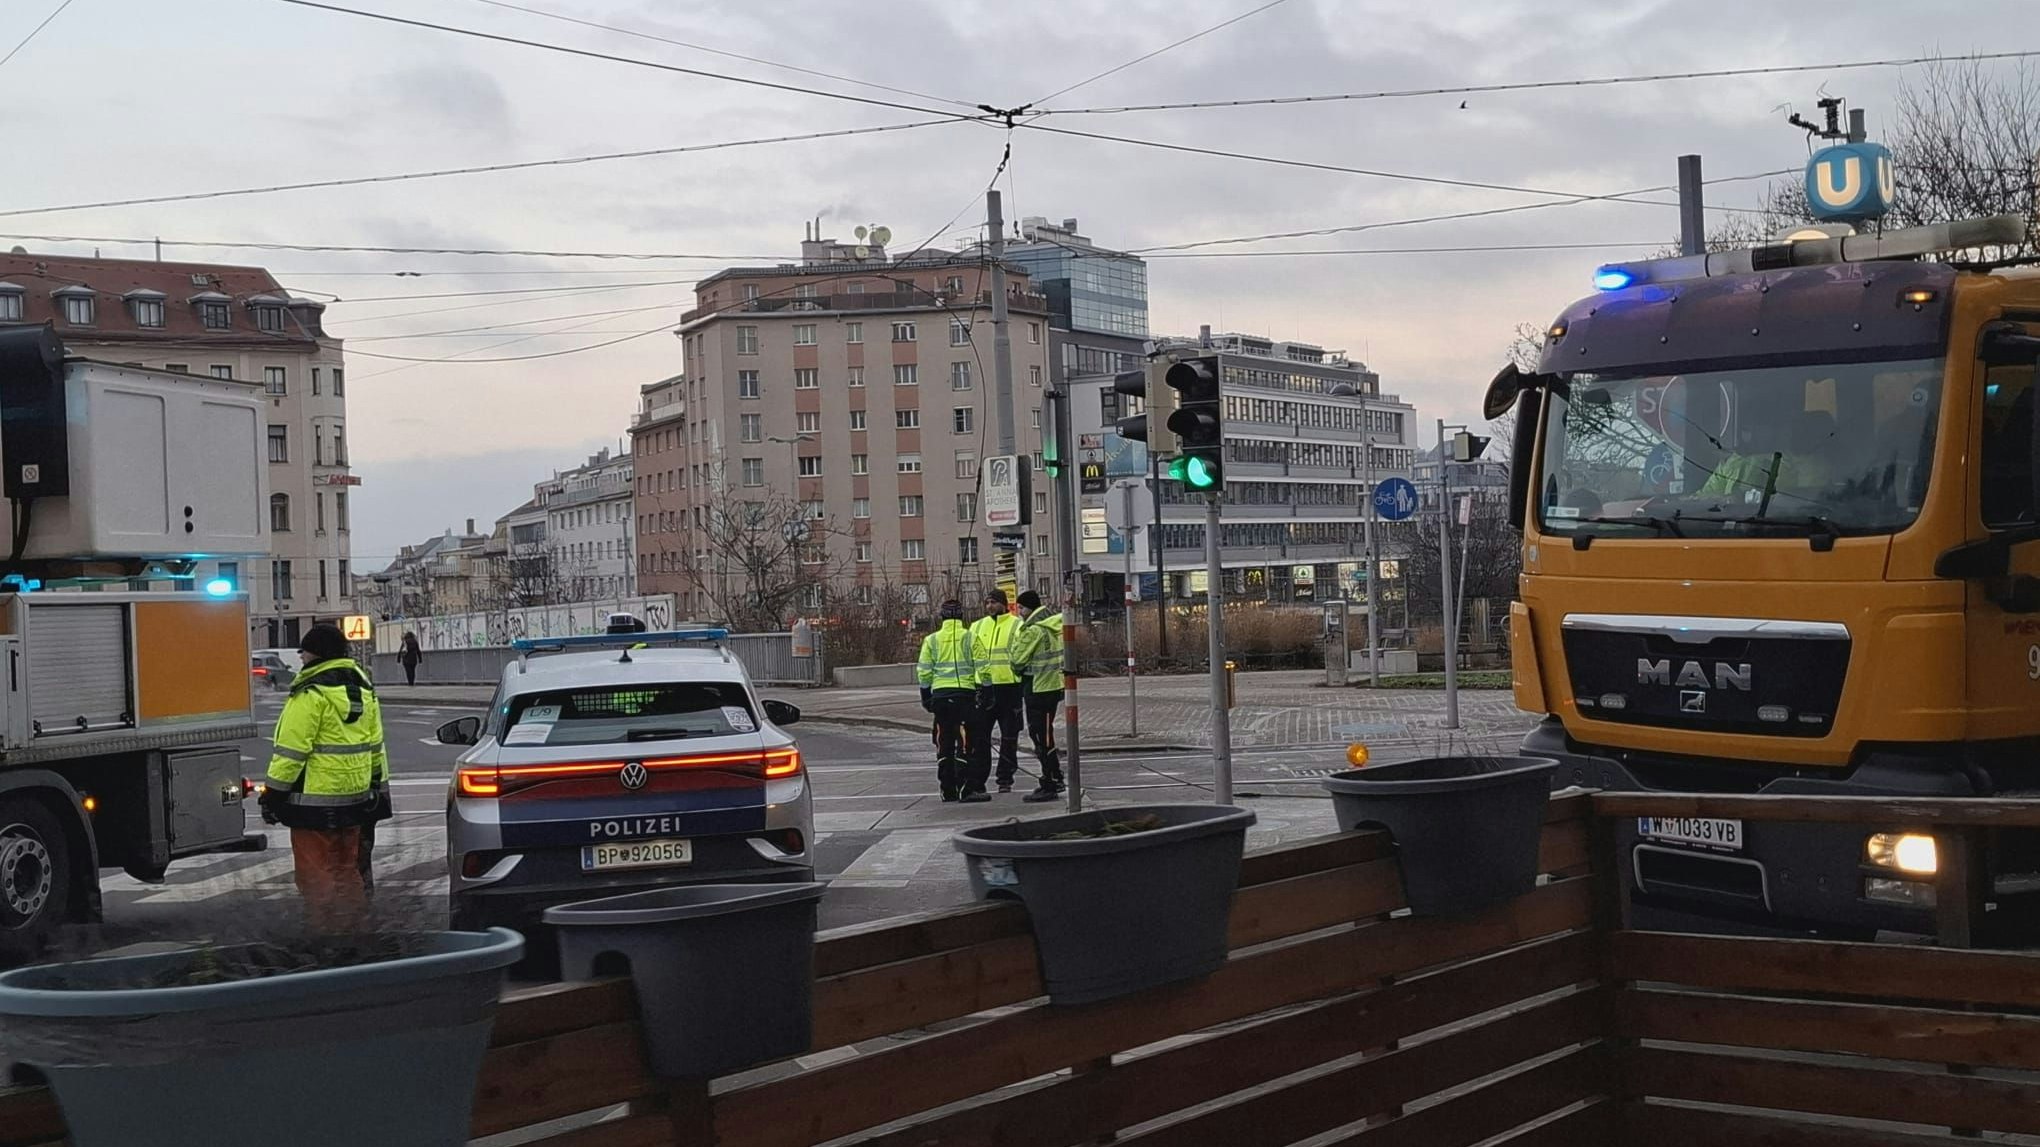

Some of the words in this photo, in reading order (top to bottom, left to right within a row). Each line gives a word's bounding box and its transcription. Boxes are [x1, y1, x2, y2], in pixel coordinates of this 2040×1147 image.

[1816, 157, 1861, 207] U
[1637, 658, 1751, 690] MAN
[590, 817, 680, 837] POLIZEI
[1651, 817, 1663, 833] W
[1675, 818, 1712, 839] 1033
[1715, 822, 1736, 842] VB
[597, 849, 618, 865] BP
[631, 843, 683, 862] 92056
